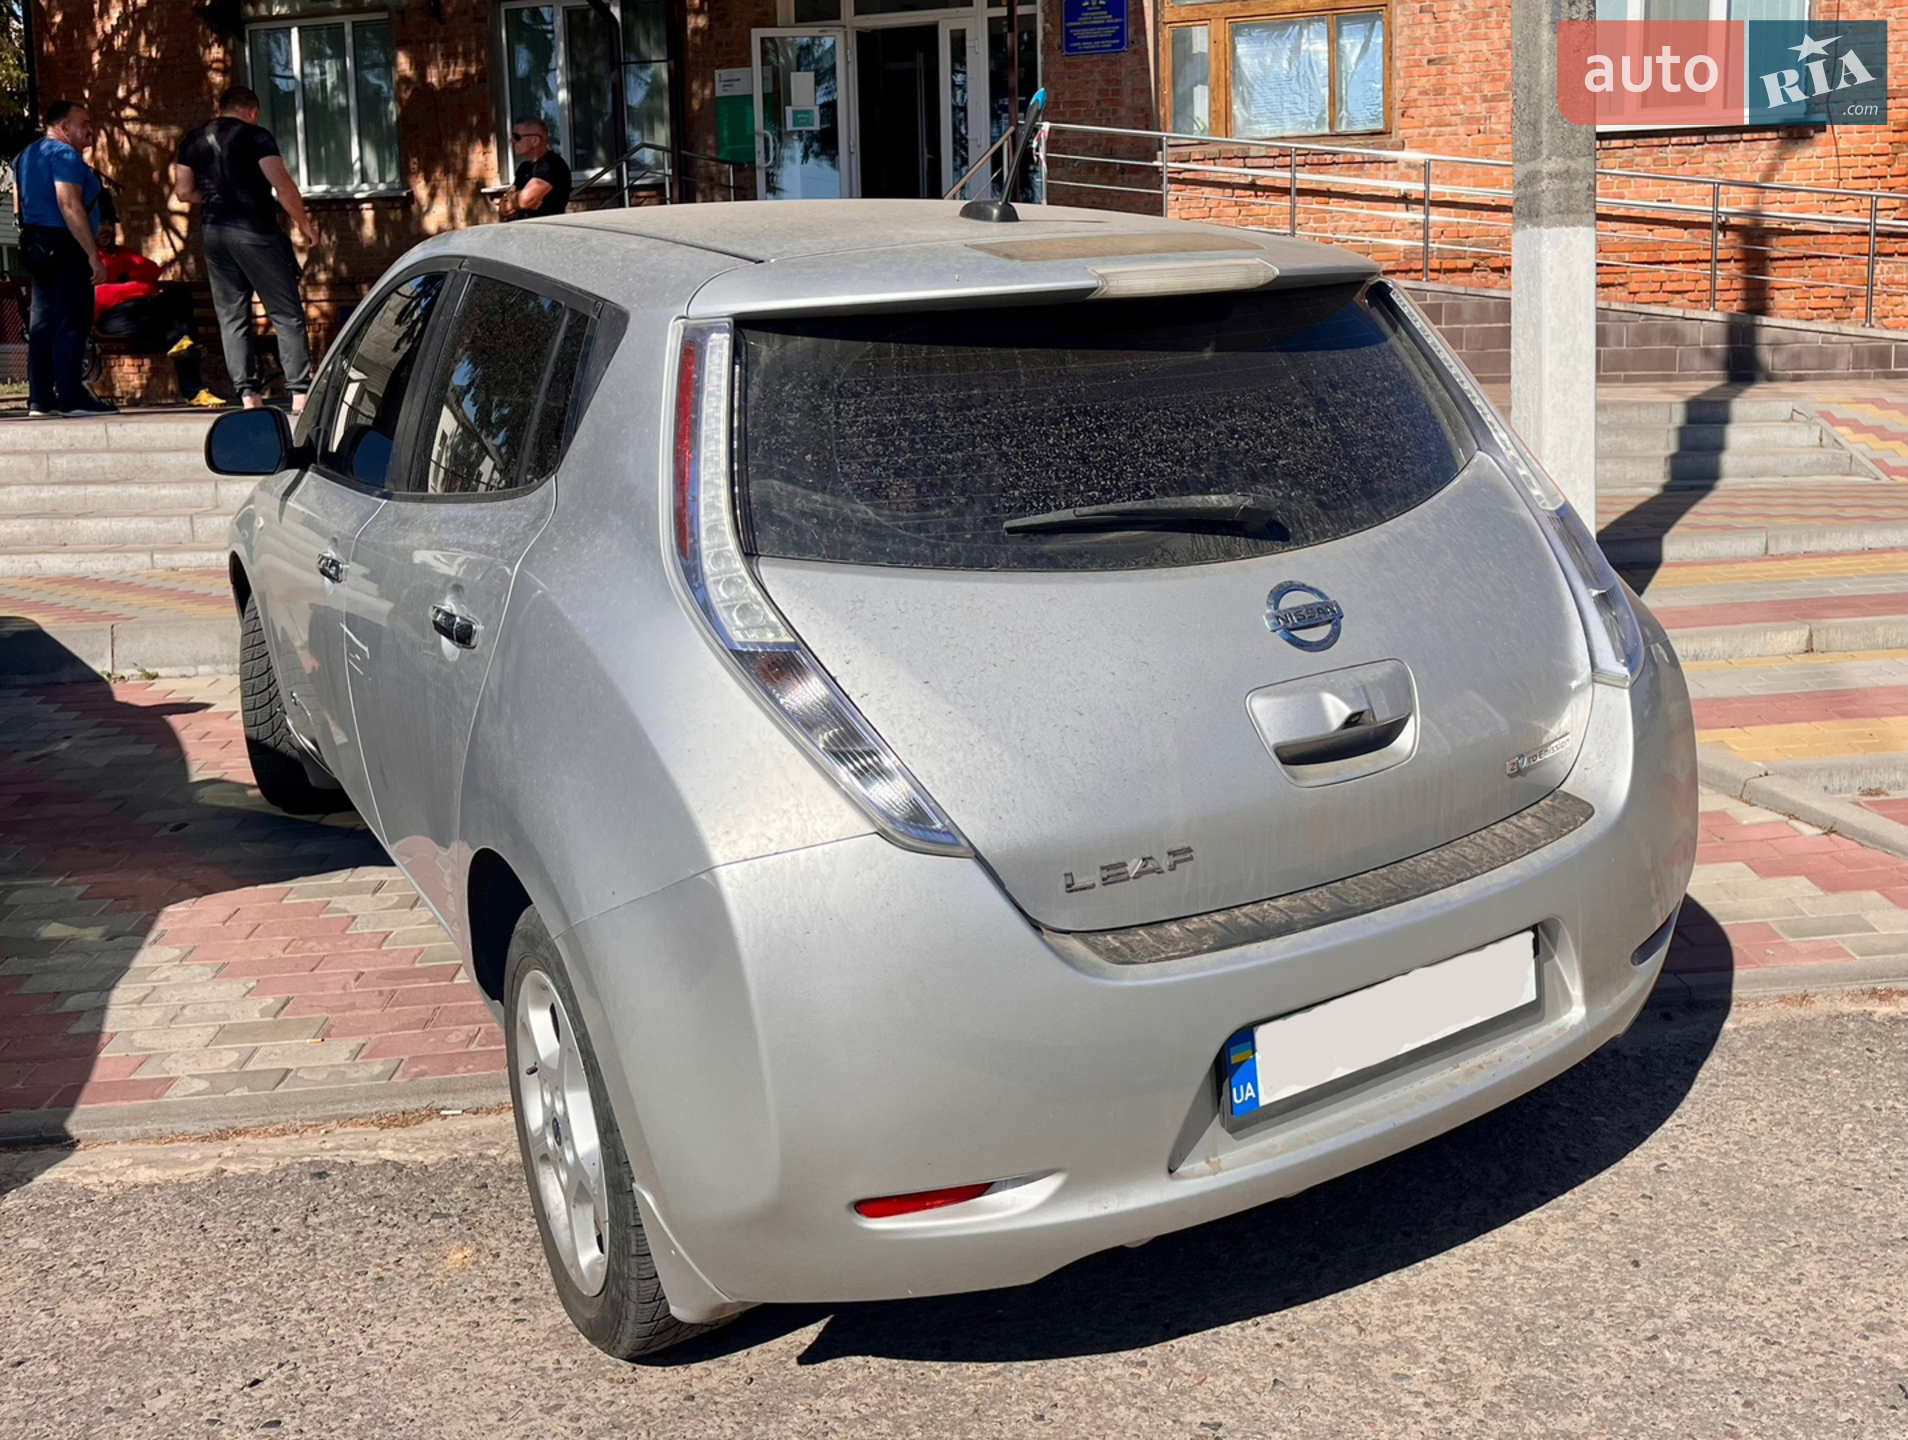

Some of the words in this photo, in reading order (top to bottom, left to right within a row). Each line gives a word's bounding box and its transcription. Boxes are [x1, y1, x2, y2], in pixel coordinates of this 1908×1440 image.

[1275, 602, 1338, 626] NISSAN
[1063, 846, 1194, 893] LEAF
[1232, 1081, 1256, 1104] UA
